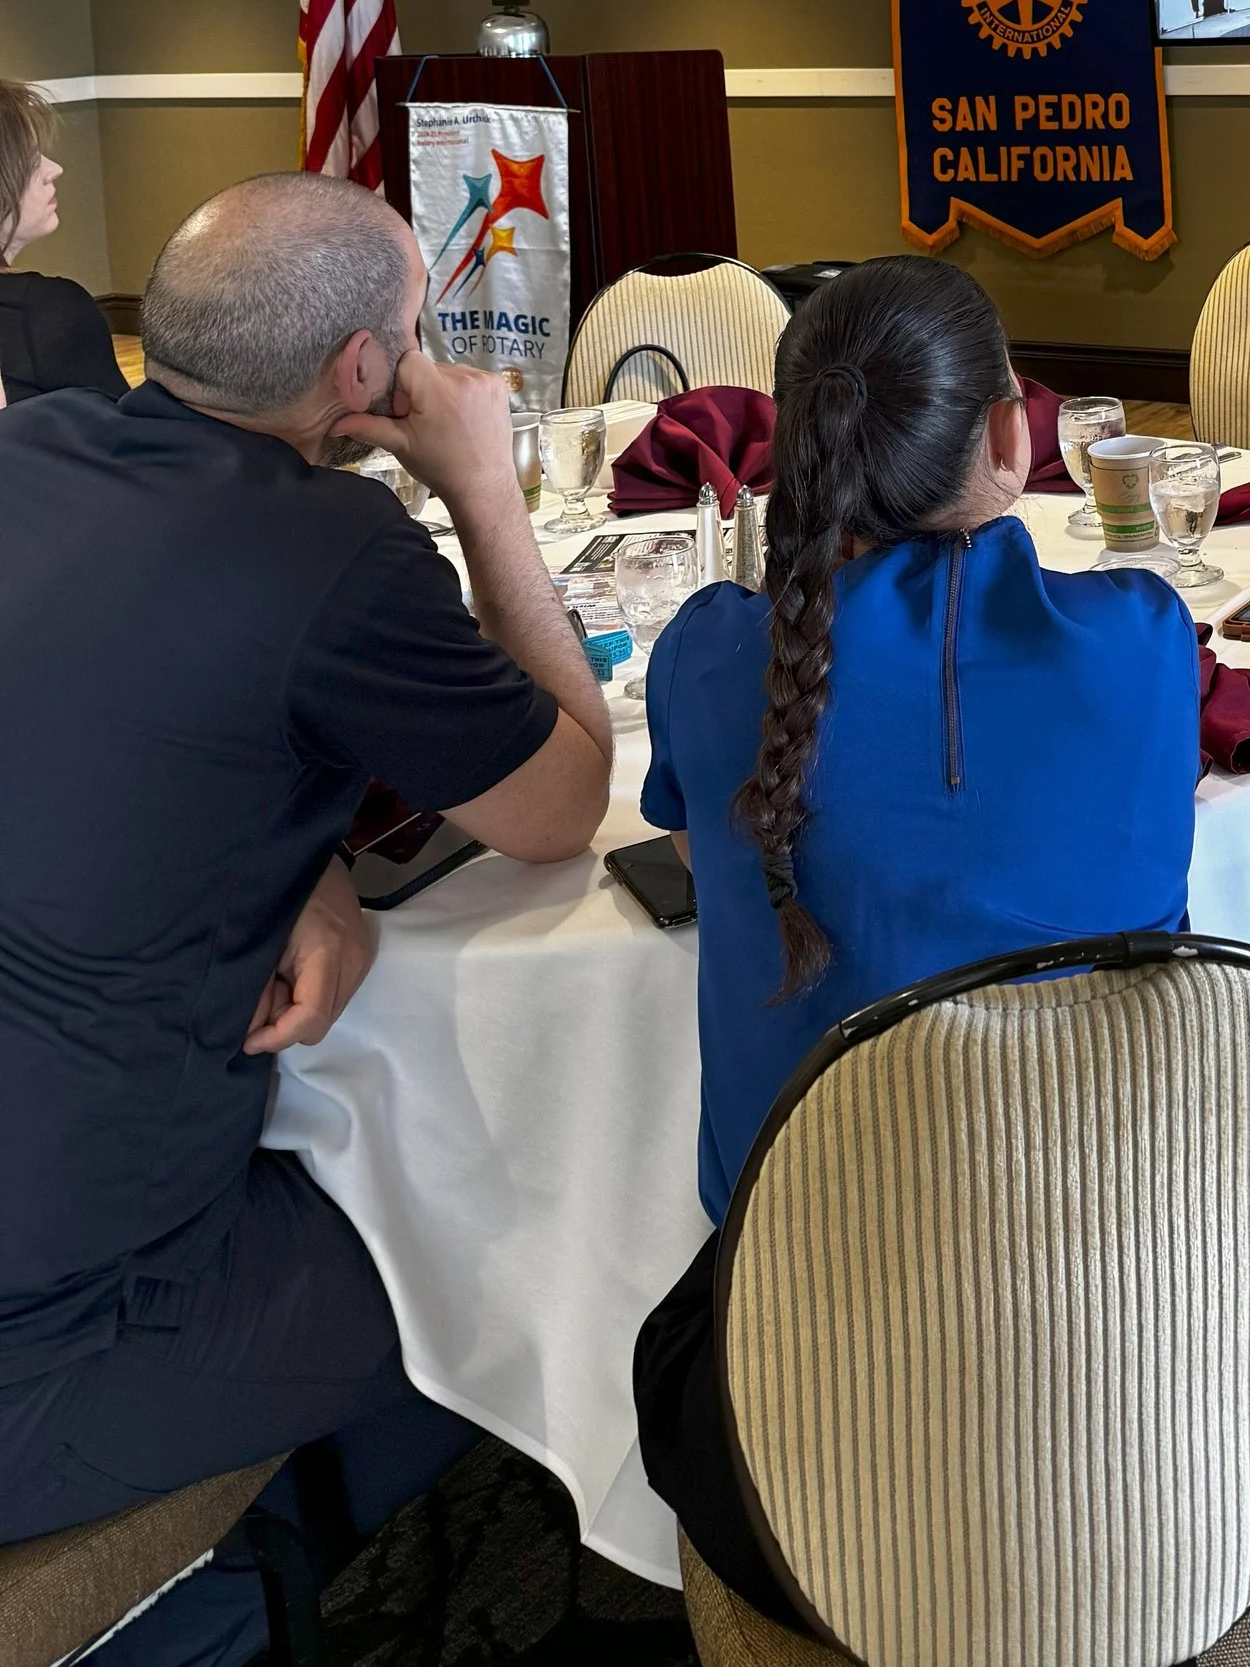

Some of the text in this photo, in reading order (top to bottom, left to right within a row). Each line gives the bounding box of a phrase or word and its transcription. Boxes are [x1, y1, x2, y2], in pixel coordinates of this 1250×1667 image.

[979, 6, 1071, 43] INTERNATIONAL
[931, 92, 1131, 132] SAN PEDRO
[933, 145, 1134, 182] CALIFORNIA
[438, 310, 480, 332] THE
[452, 335, 478, 354] OF
